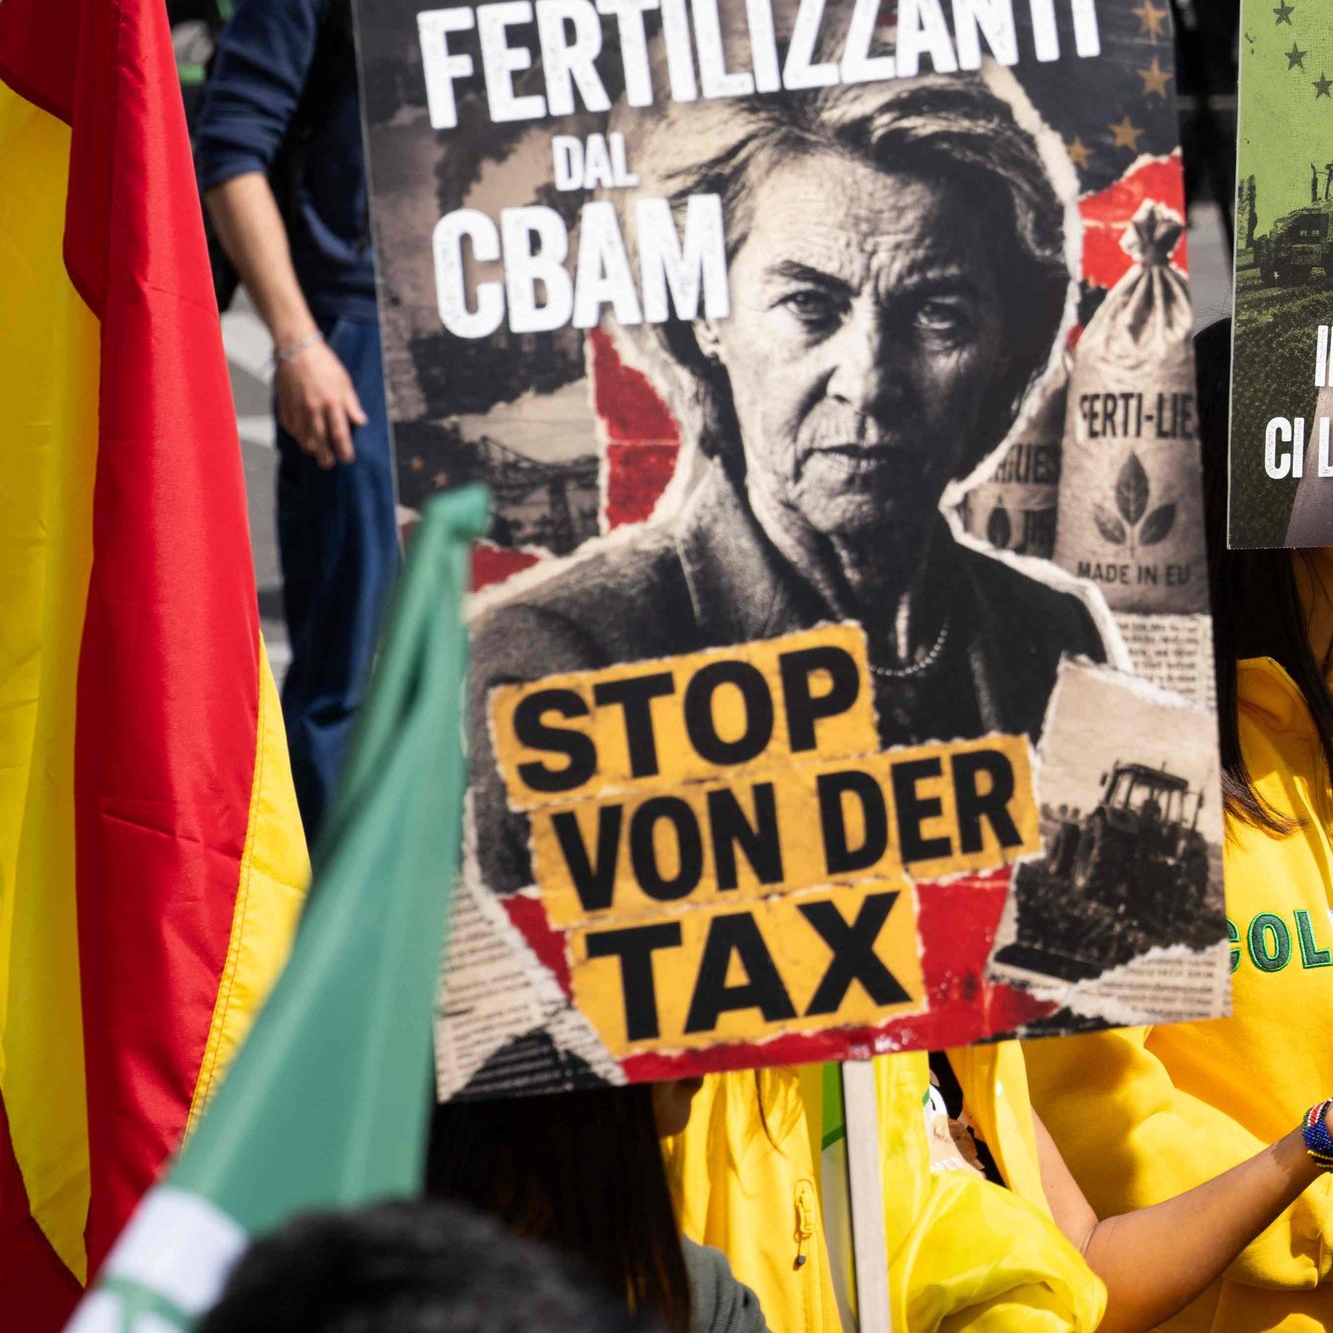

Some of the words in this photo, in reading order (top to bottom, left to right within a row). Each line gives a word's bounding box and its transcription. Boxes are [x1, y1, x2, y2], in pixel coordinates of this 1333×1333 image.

[552, 132, 640, 193] DAL
[431, 193, 731, 340] CBAM
[1265, 417, 1305, 480] CI
[1077, 561, 1129, 583] MADE
[1137, 563, 1157, 585] IN
[1164, 563, 1191, 587] EU
[510, 645, 860, 792] STOP
[549, 780, 782, 912] VON
[816, 747, 1023, 867] DER
[584, 891, 915, 1043] TAX
